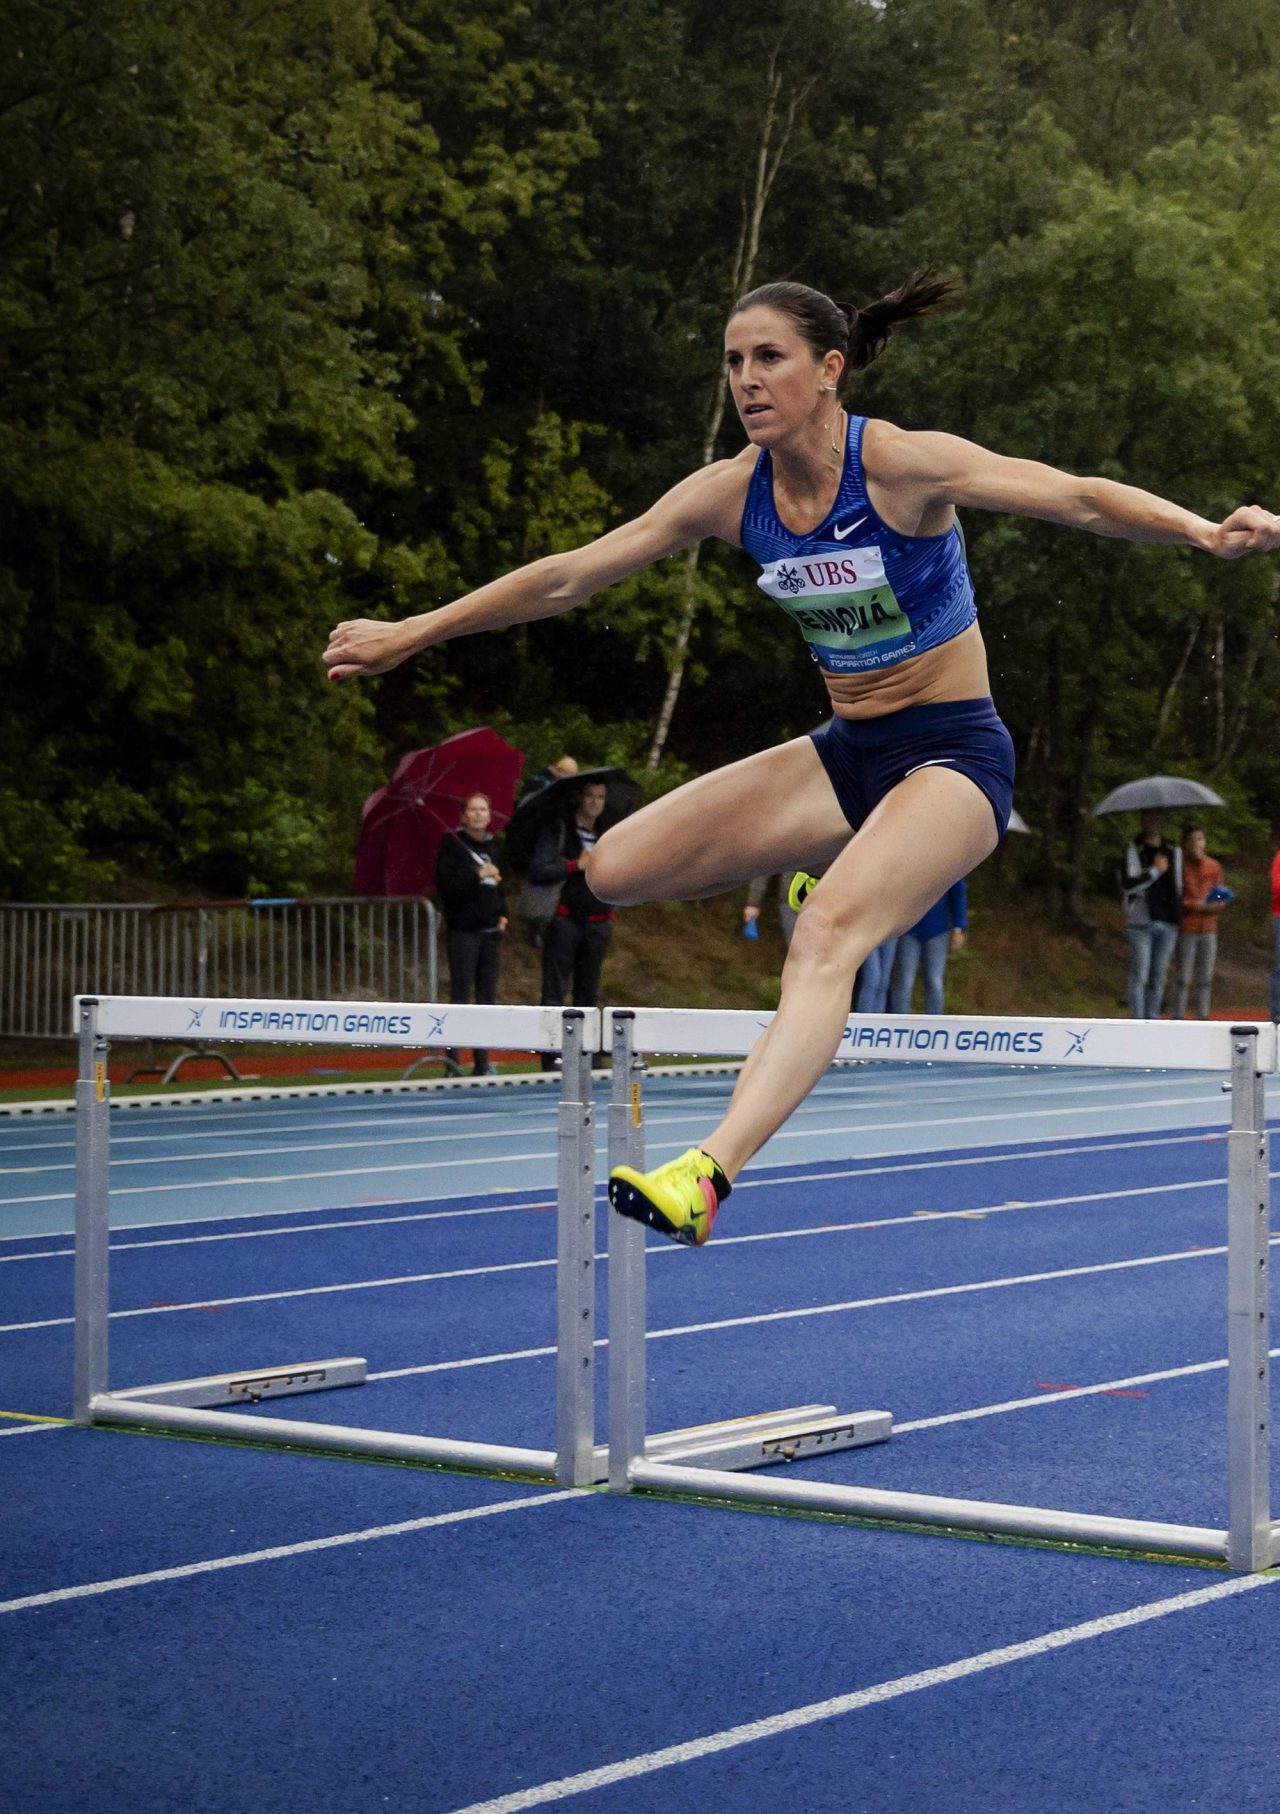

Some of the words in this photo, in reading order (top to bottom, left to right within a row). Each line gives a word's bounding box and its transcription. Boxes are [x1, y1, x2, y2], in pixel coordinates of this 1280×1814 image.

[802, 560, 857, 587] UBS
[792, 594, 897, 635] EJNOVÁ
[881, 641, 917, 662] GAMES
[219, 1010, 338, 1032] INSPIRATION
[343, 1014, 412, 1035] GAMES
[842, 1027, 949, 1050] PIRATION
[955, 1029, 1043, 1054] GAMES
